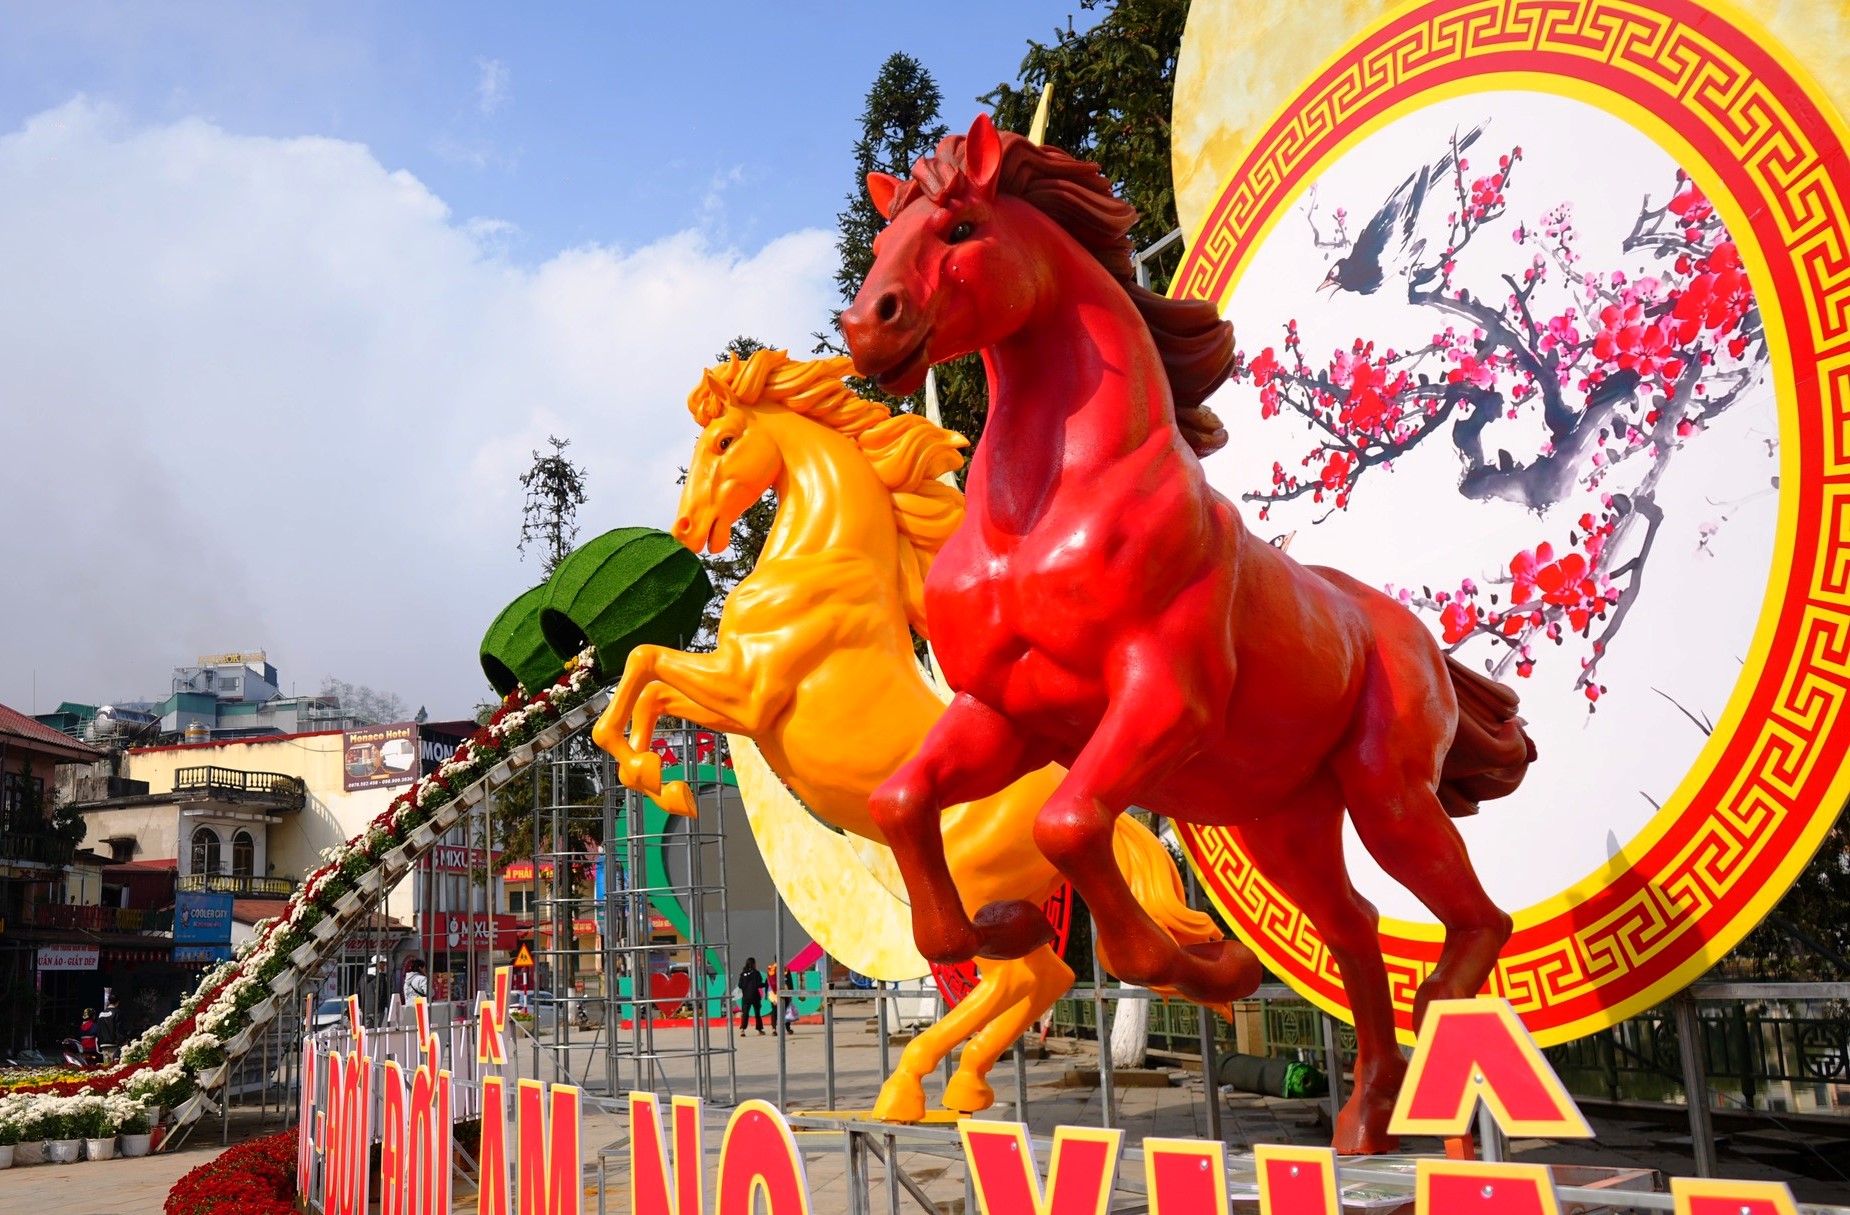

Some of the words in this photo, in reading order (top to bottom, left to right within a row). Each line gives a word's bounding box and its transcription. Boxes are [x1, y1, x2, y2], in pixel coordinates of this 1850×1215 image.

[350, 733, 385, 743] Monaco
[386, 728, 410, 738] Hotel
[461, 921, 499, 938] MXUE
[54, 955, 63, 966] ÁO
[84, 956, 96, 966] DÉP
